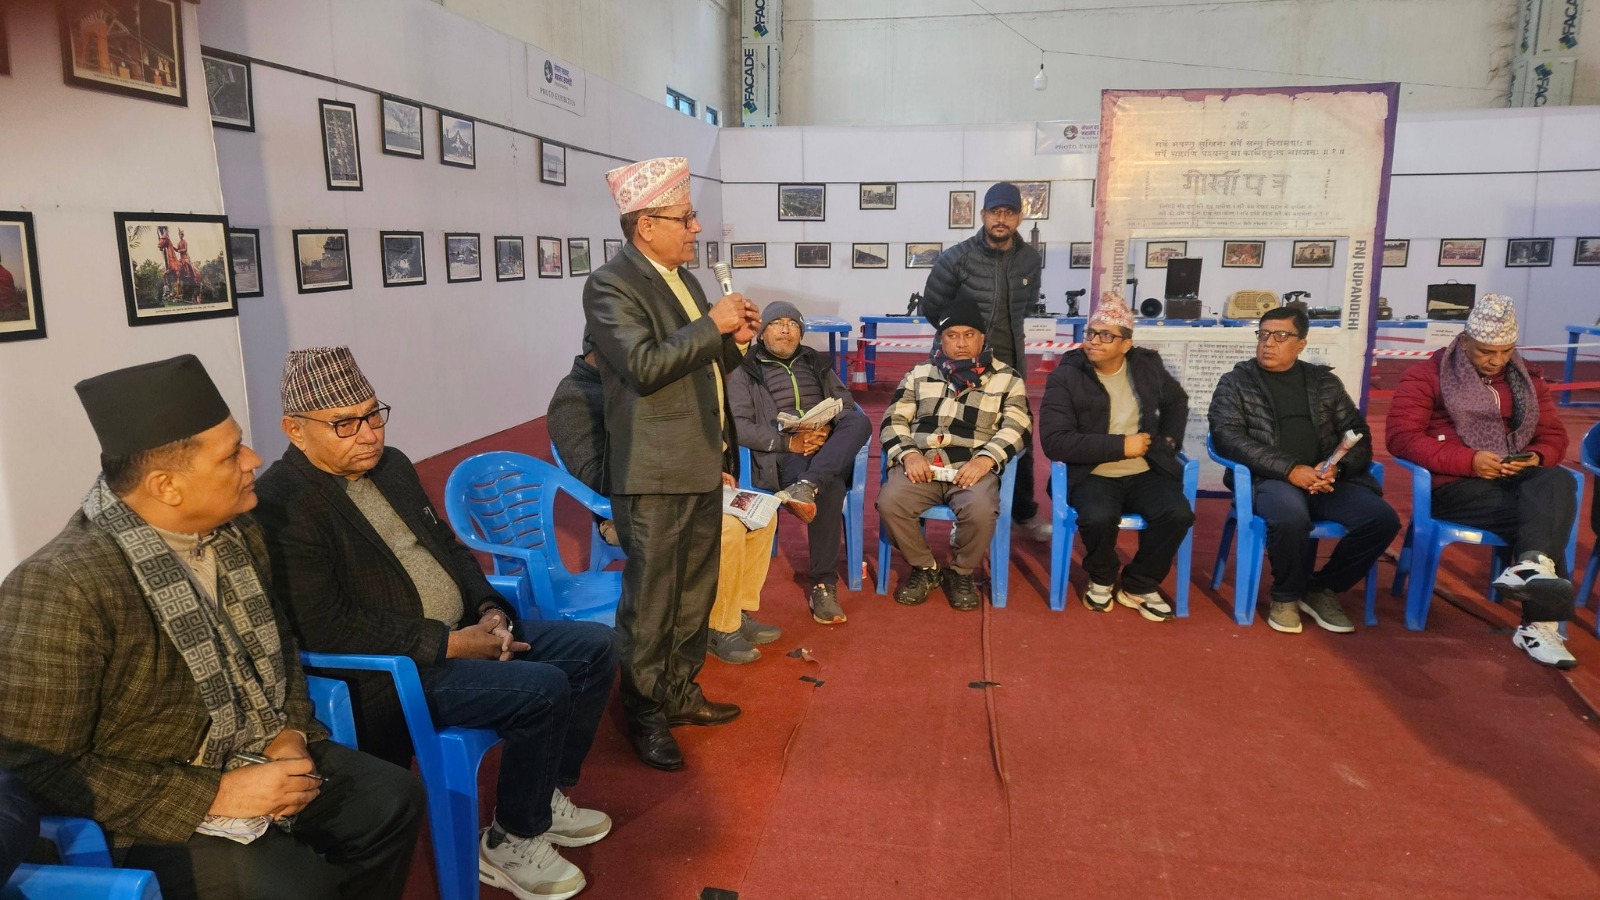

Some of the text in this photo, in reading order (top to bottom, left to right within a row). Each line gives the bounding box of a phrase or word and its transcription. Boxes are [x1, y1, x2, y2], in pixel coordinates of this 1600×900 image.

[744, 49, 754, 101] FACADE
[1534, 78, 1550, 107] FAC
[1347, 240, 1366, 330] FNJ RUPANDEHI
